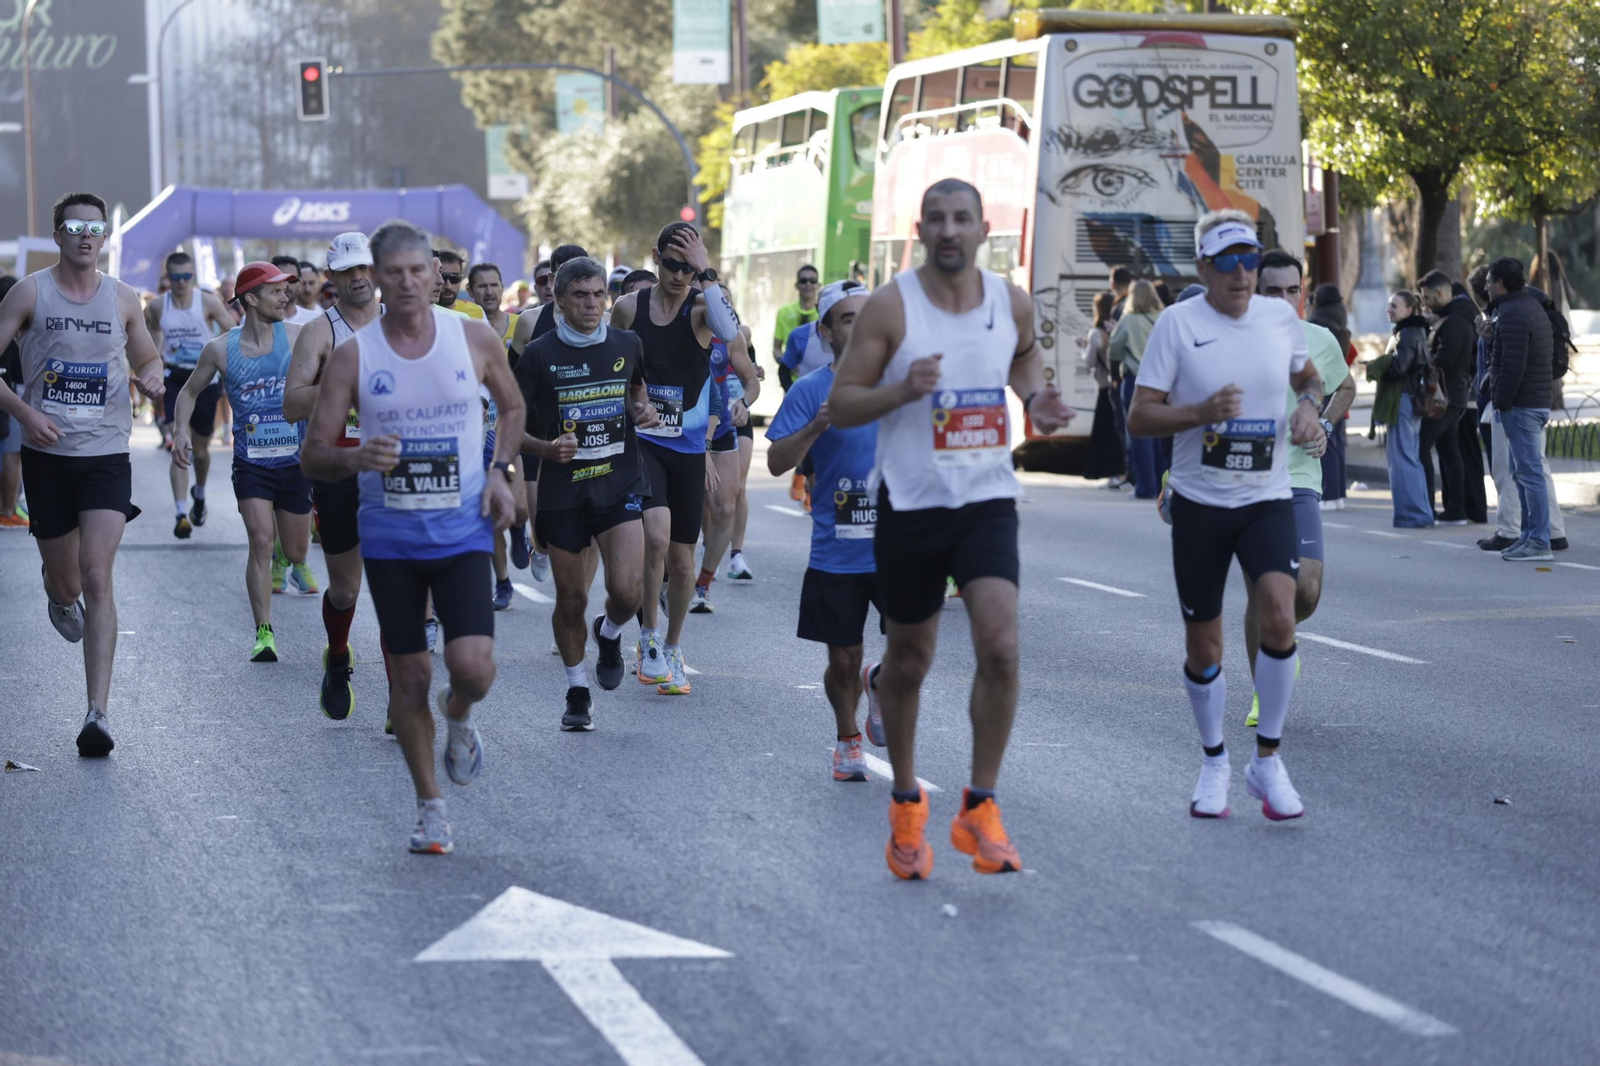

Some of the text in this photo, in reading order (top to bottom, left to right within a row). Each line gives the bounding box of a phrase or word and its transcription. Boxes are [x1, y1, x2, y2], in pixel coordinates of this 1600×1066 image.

[1073, 74, 1272, 109] GODSPELL
[1209, 113, 1274, 123] EL MUSICAL
[1236, 155, 1297, 165] CARTUJA
[1236, 167, 1287, 178] CENTER
[65, 317, 111, 334] NYC
[68, 365, 102, 375] ZURICH
[65, 381, 87, 390] 14604
[48, 388, 101, 404] CARLSON
[558, 384, 626, 402] BARCELONA
[648, 387, 677, 397] ZURICH
[406, 402, 468, 420] CALIFATO
[585, 406, 617, 417] ZURICH
[262, 414, 285, 422] ZURIC
[587, 423, 605, 432] 4263
[1231, 422, 1270, 433] ZURICH
[247, 436, 298, 447] ALEXANDRE
[582, 433, 610, 447] JOSE
[406, 441, 450, 453] ZURICH
[1225, 454, 1253, 469] SEB
[385, 475, 459, 492] DEL VALLE
[852, 509, 878, 523] HUG
